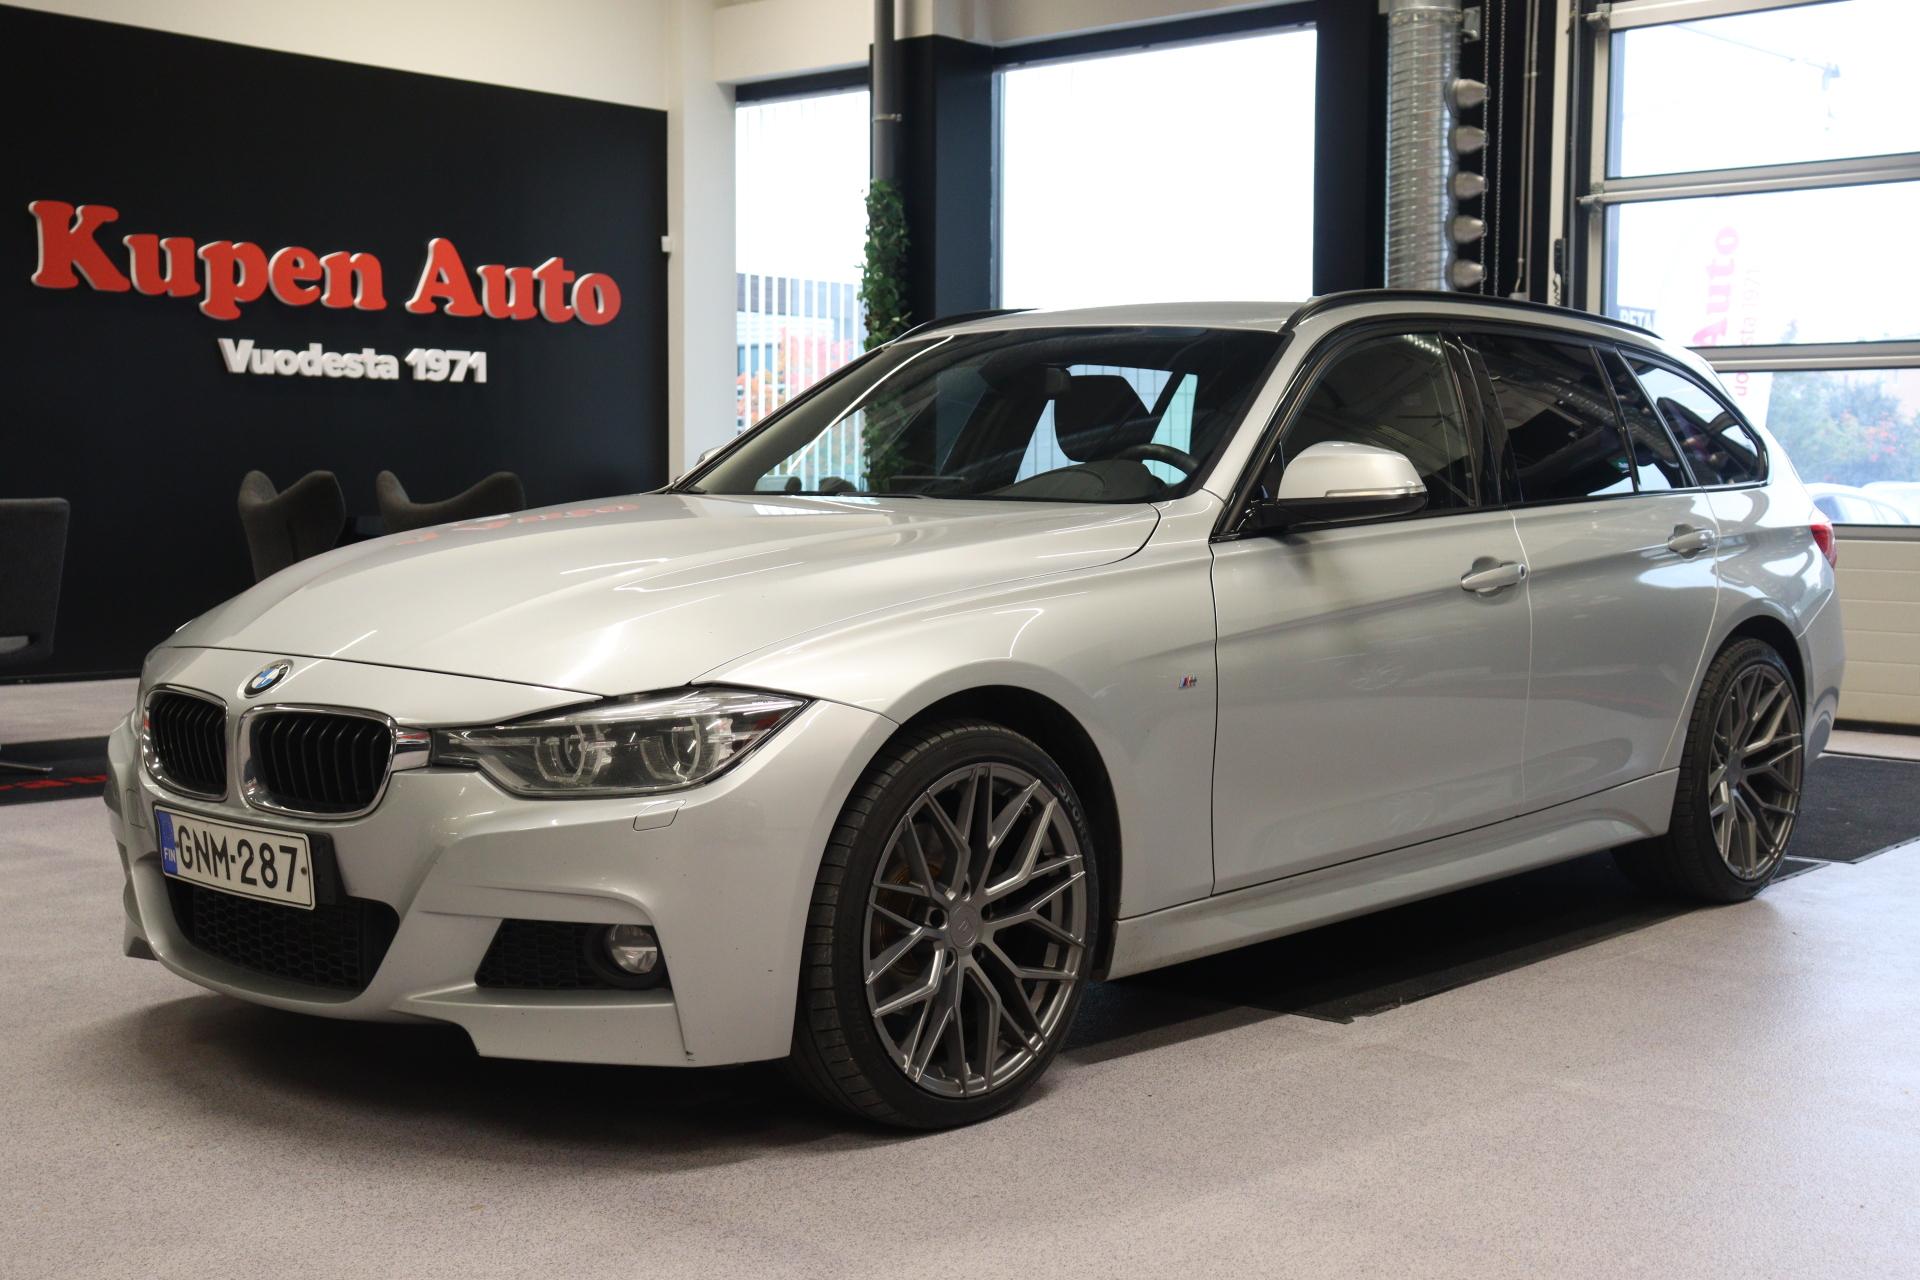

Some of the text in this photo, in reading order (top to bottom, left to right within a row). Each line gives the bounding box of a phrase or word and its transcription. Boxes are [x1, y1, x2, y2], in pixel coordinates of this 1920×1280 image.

[28, 200, 622, 326] Kupen Auto
[218, 337, 488, 384] Vuodesta 1971
[164, 847, 177, 862] FIN
